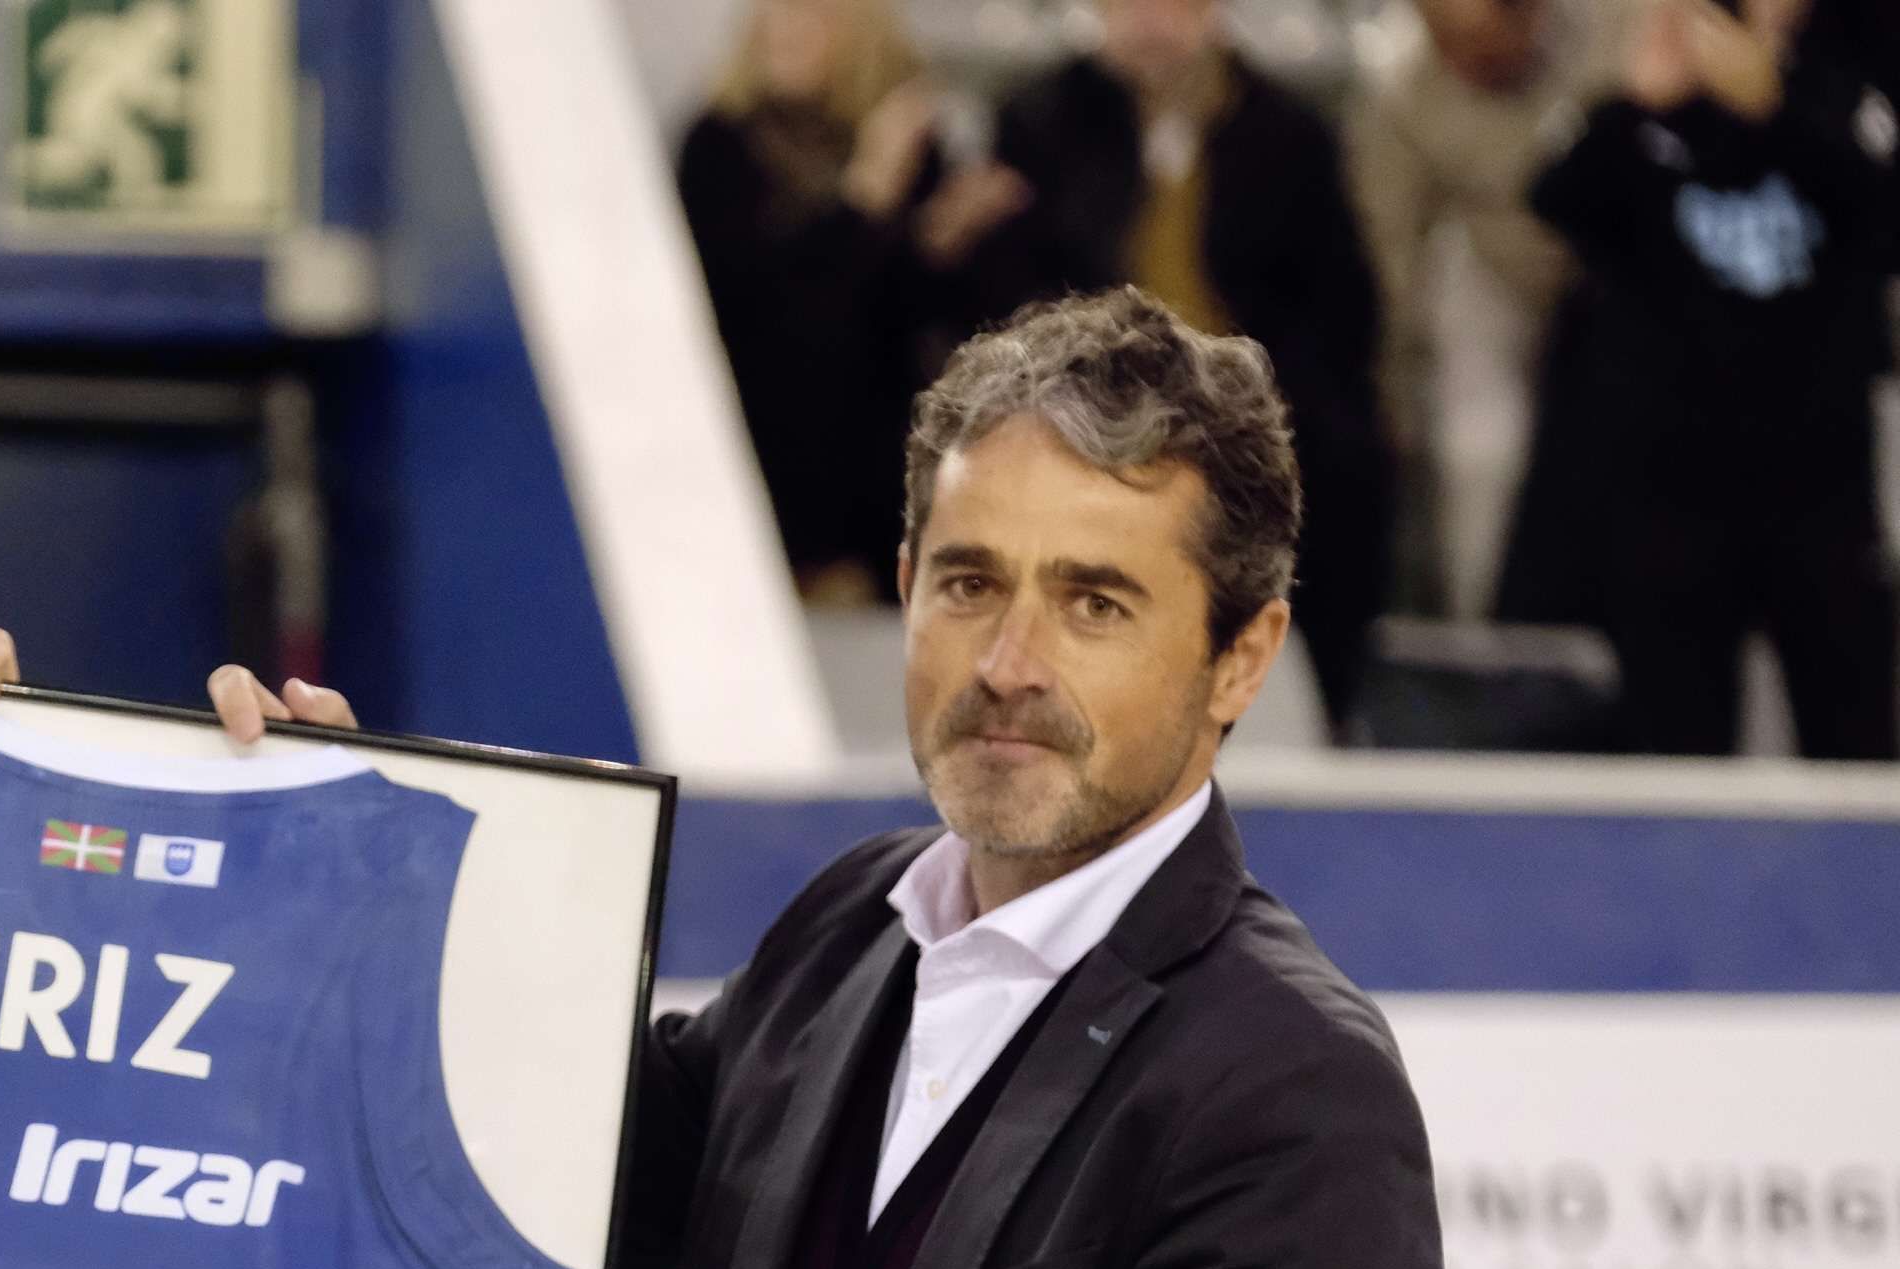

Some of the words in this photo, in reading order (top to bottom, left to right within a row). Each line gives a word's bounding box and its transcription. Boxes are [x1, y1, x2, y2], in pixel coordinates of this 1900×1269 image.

[9, 1123, 306, 1227] Irizar
[1436, 1160, 1608, 1254] NO
[1650, 1160, 1900, 1256] VIRG
